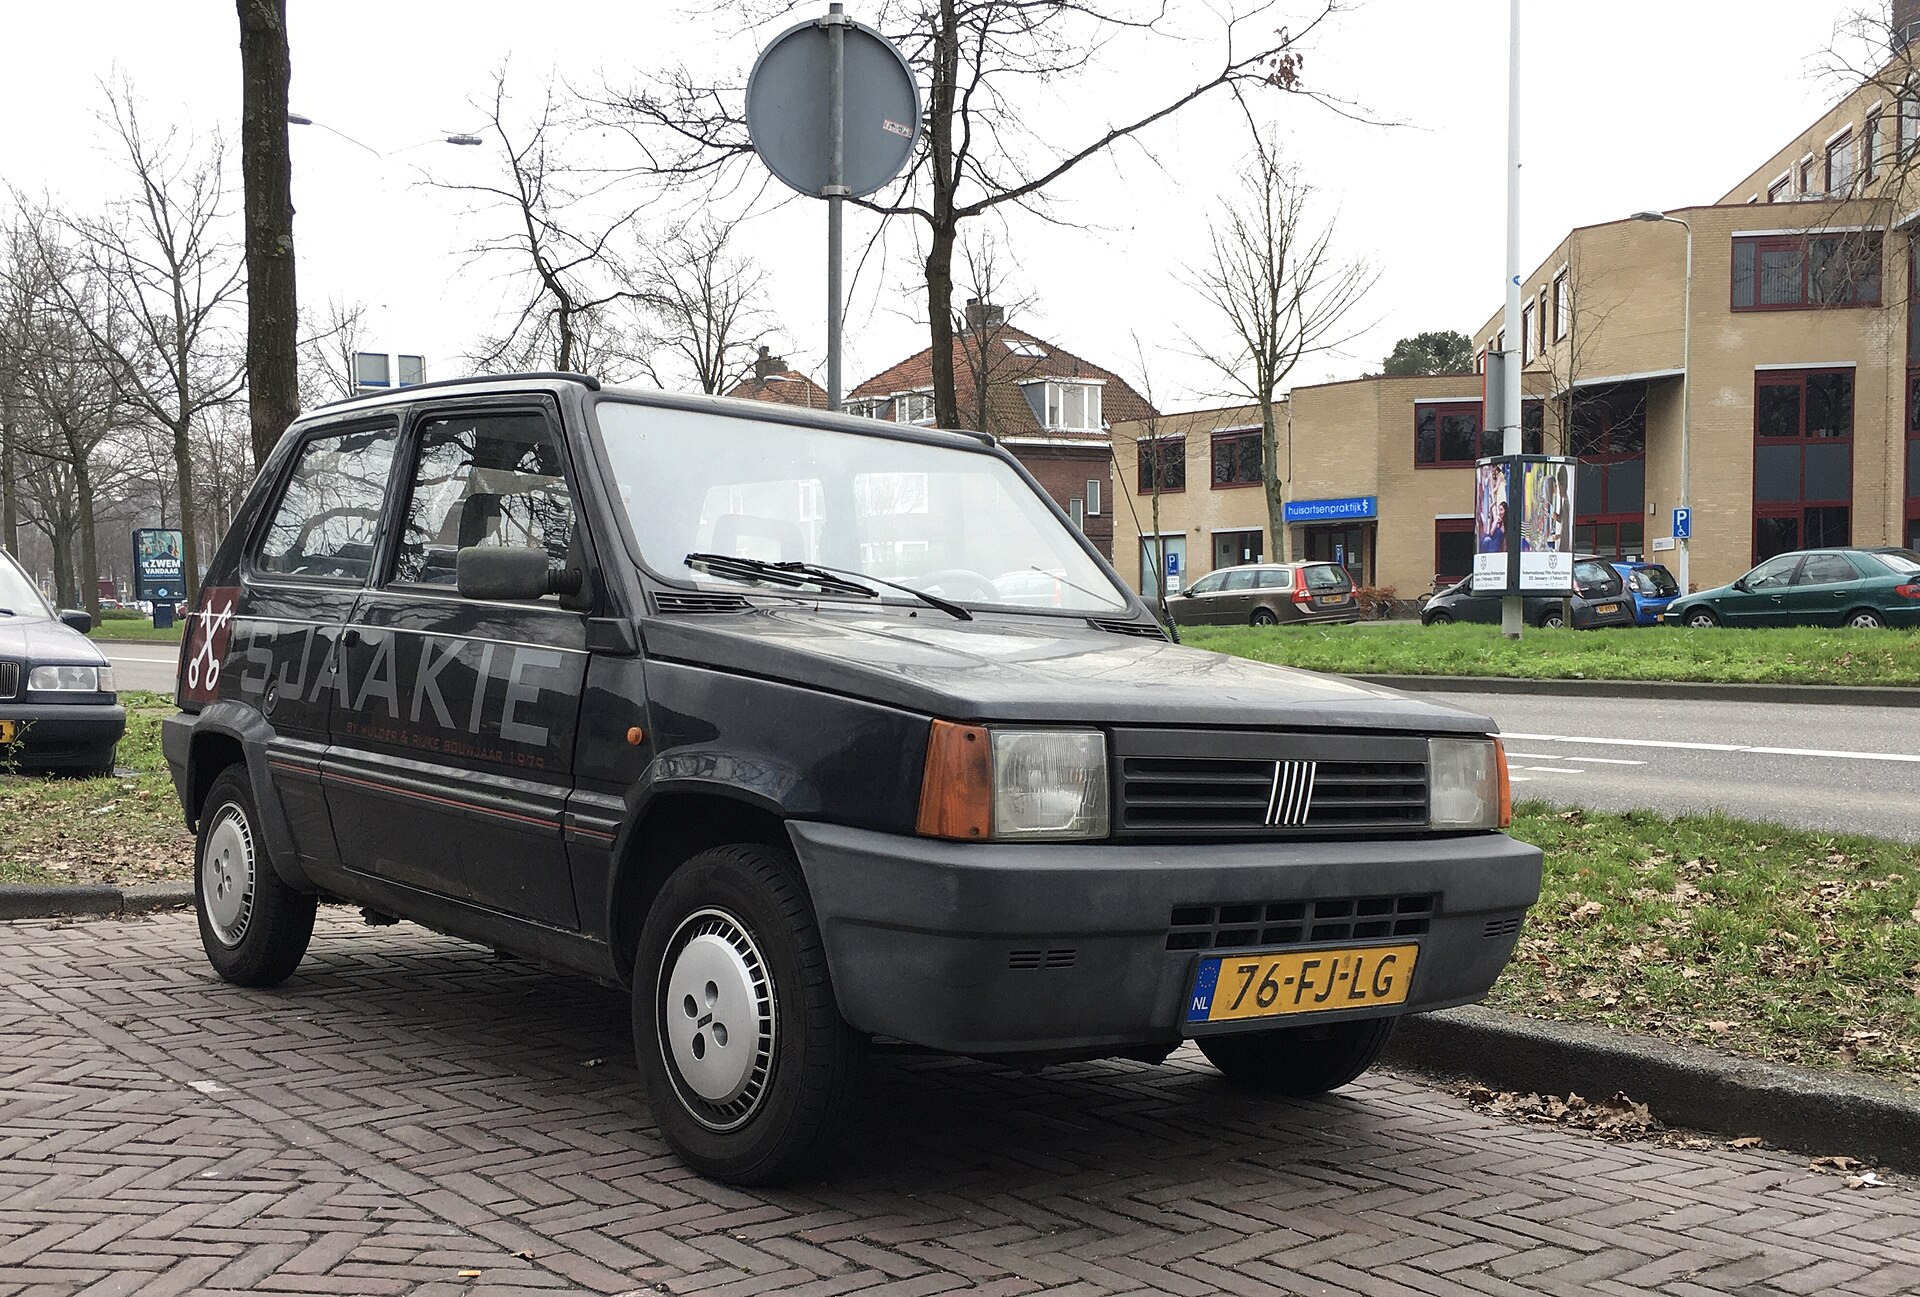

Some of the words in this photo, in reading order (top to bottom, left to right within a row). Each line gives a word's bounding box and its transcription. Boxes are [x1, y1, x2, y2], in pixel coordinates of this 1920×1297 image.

[1288, 502, 1361, 515] huisartsenpraktijk
[1677, 511, 1686, 526] P
[149, 560, 181, 568] ZWEM
[1168, 555, 1176, 567] P
[241, 622, 563, 746] SJAAKIE
[346, 722, 357, 733] BY
[510, 751, 545, 769] 1979
[1230, 954, 1397, 1010] 76-FJ-LG
[1192, 996, 1209, 1010] NL
